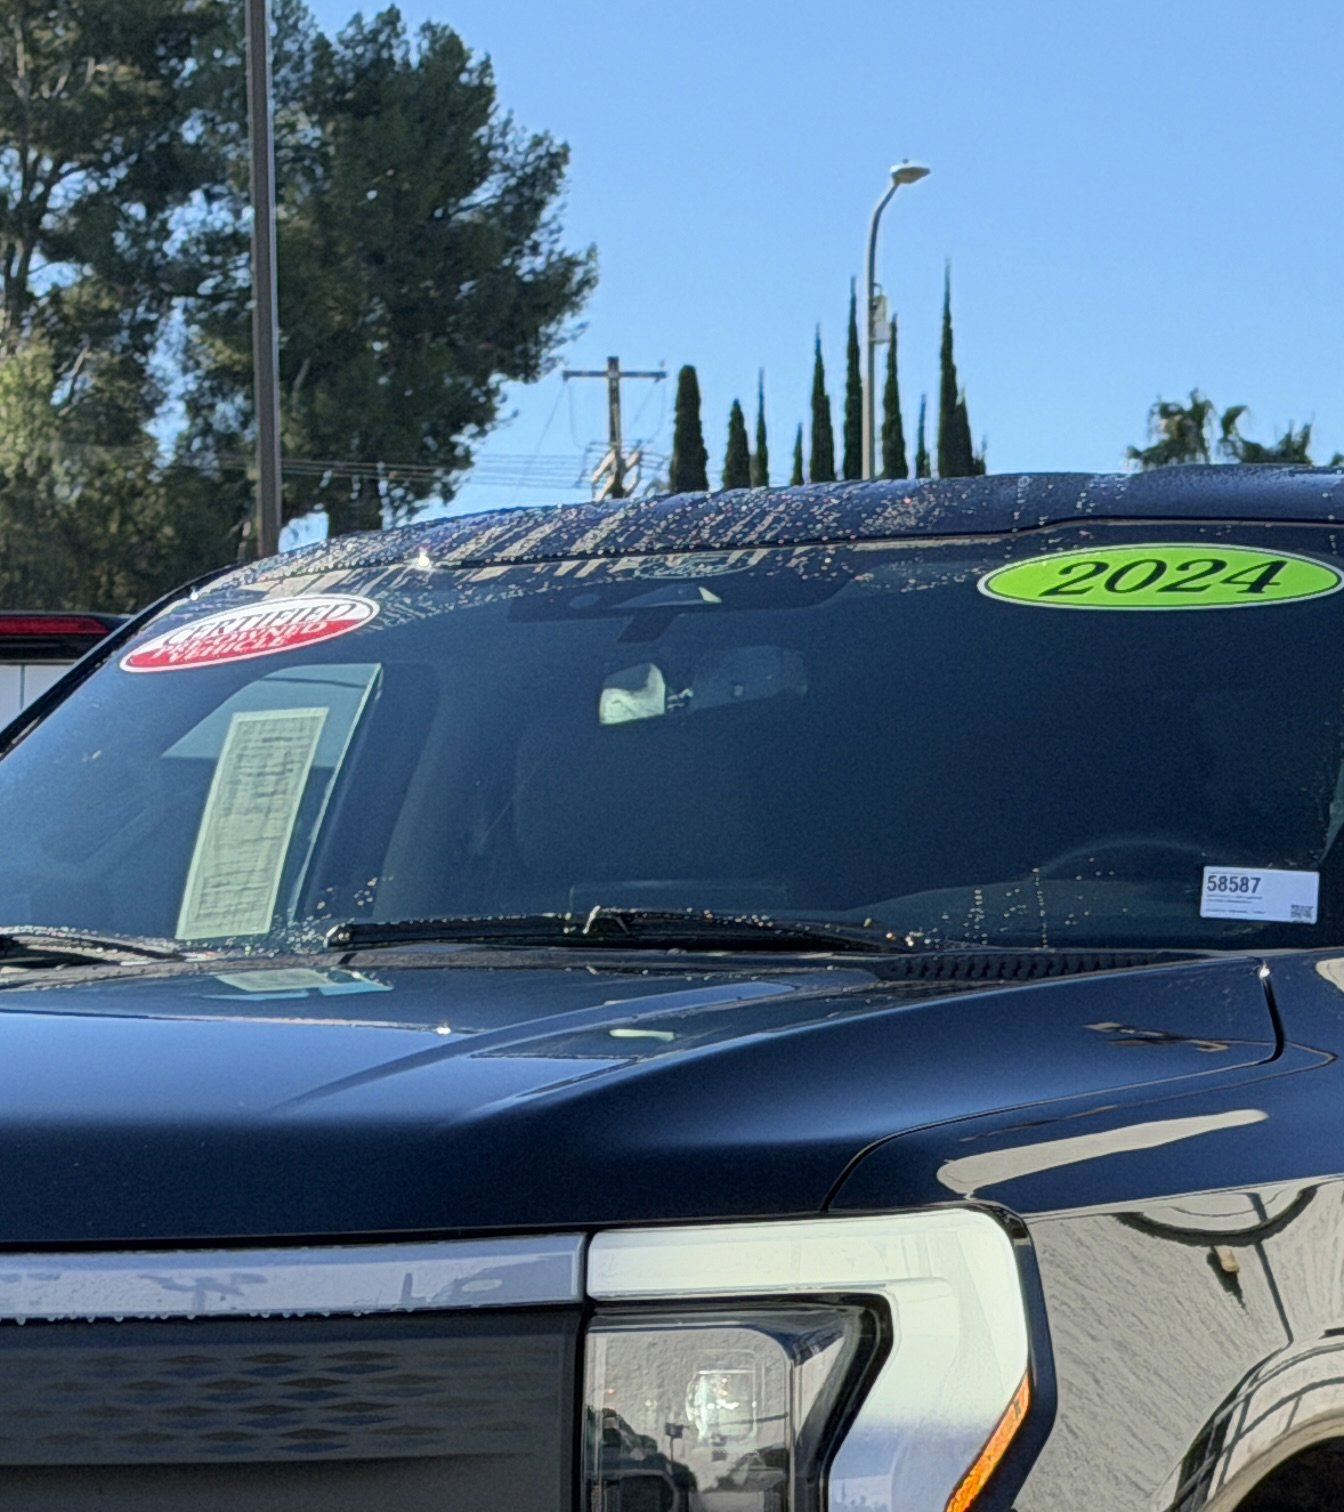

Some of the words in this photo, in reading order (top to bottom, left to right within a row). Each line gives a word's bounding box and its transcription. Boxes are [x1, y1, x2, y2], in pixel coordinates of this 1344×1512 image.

[1038, 558, 1288, 598] 2024
[163, 602, 357, 647] CERTIFIED
[169, 637, 287, 662] VEHICLE
[1206, 874, 1262, 894] 58587
